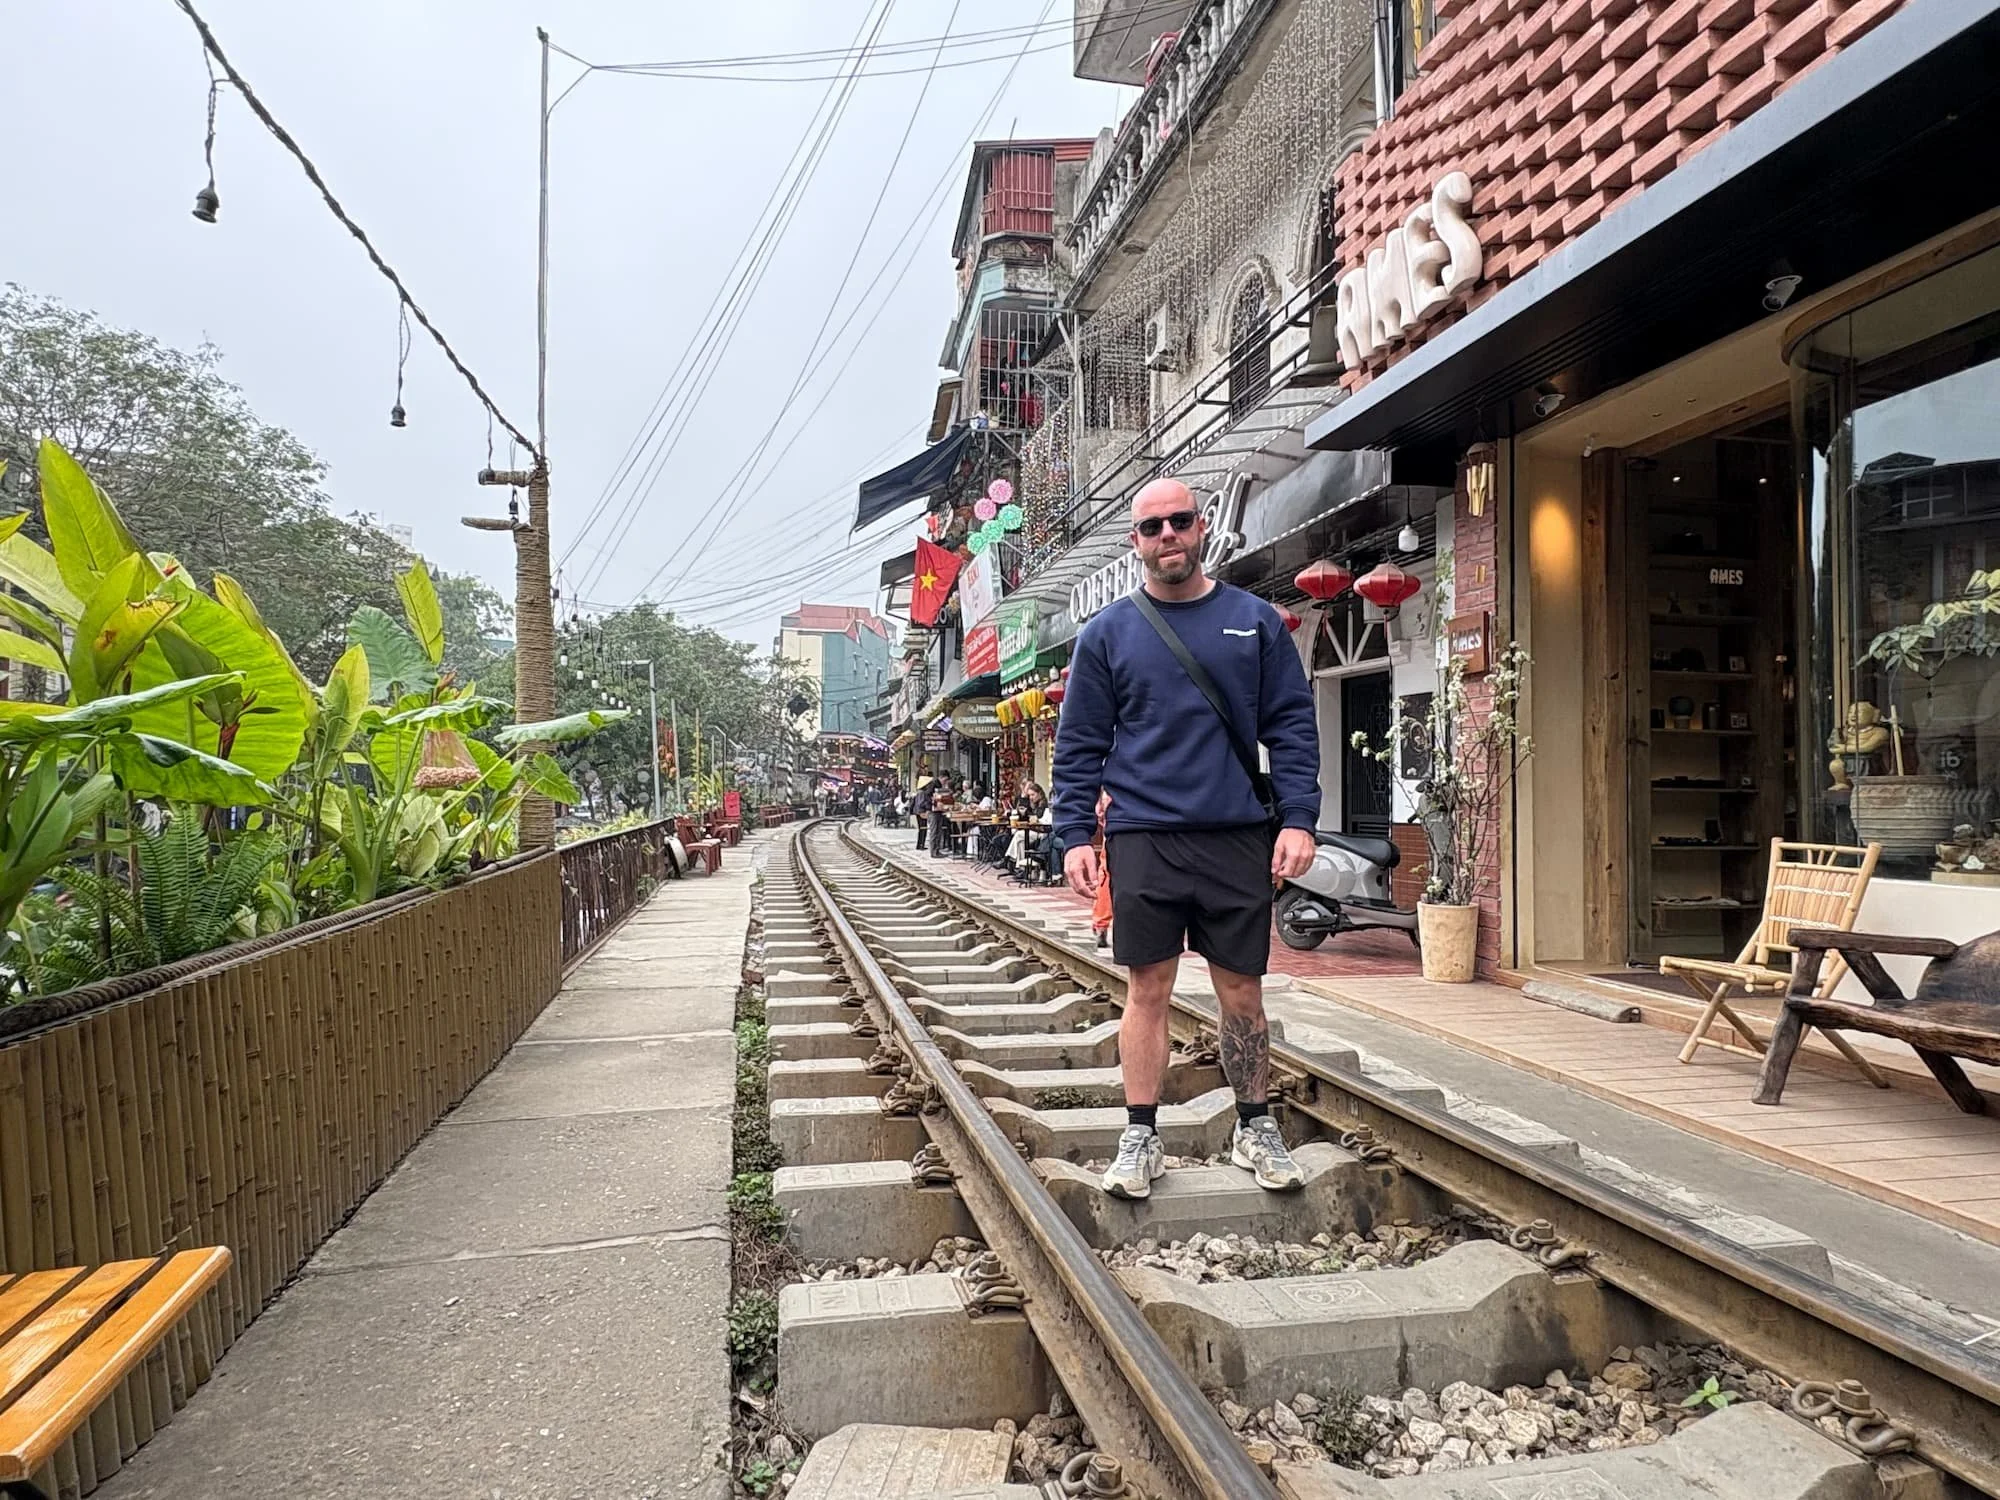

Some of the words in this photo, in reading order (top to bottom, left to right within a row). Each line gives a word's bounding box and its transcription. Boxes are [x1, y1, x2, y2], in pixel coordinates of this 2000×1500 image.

[1337, 171, 1483, 370] AMES
[1070, 550, 1139, 624] COFFEE
[1710, 568, 1744, 585] AMES
